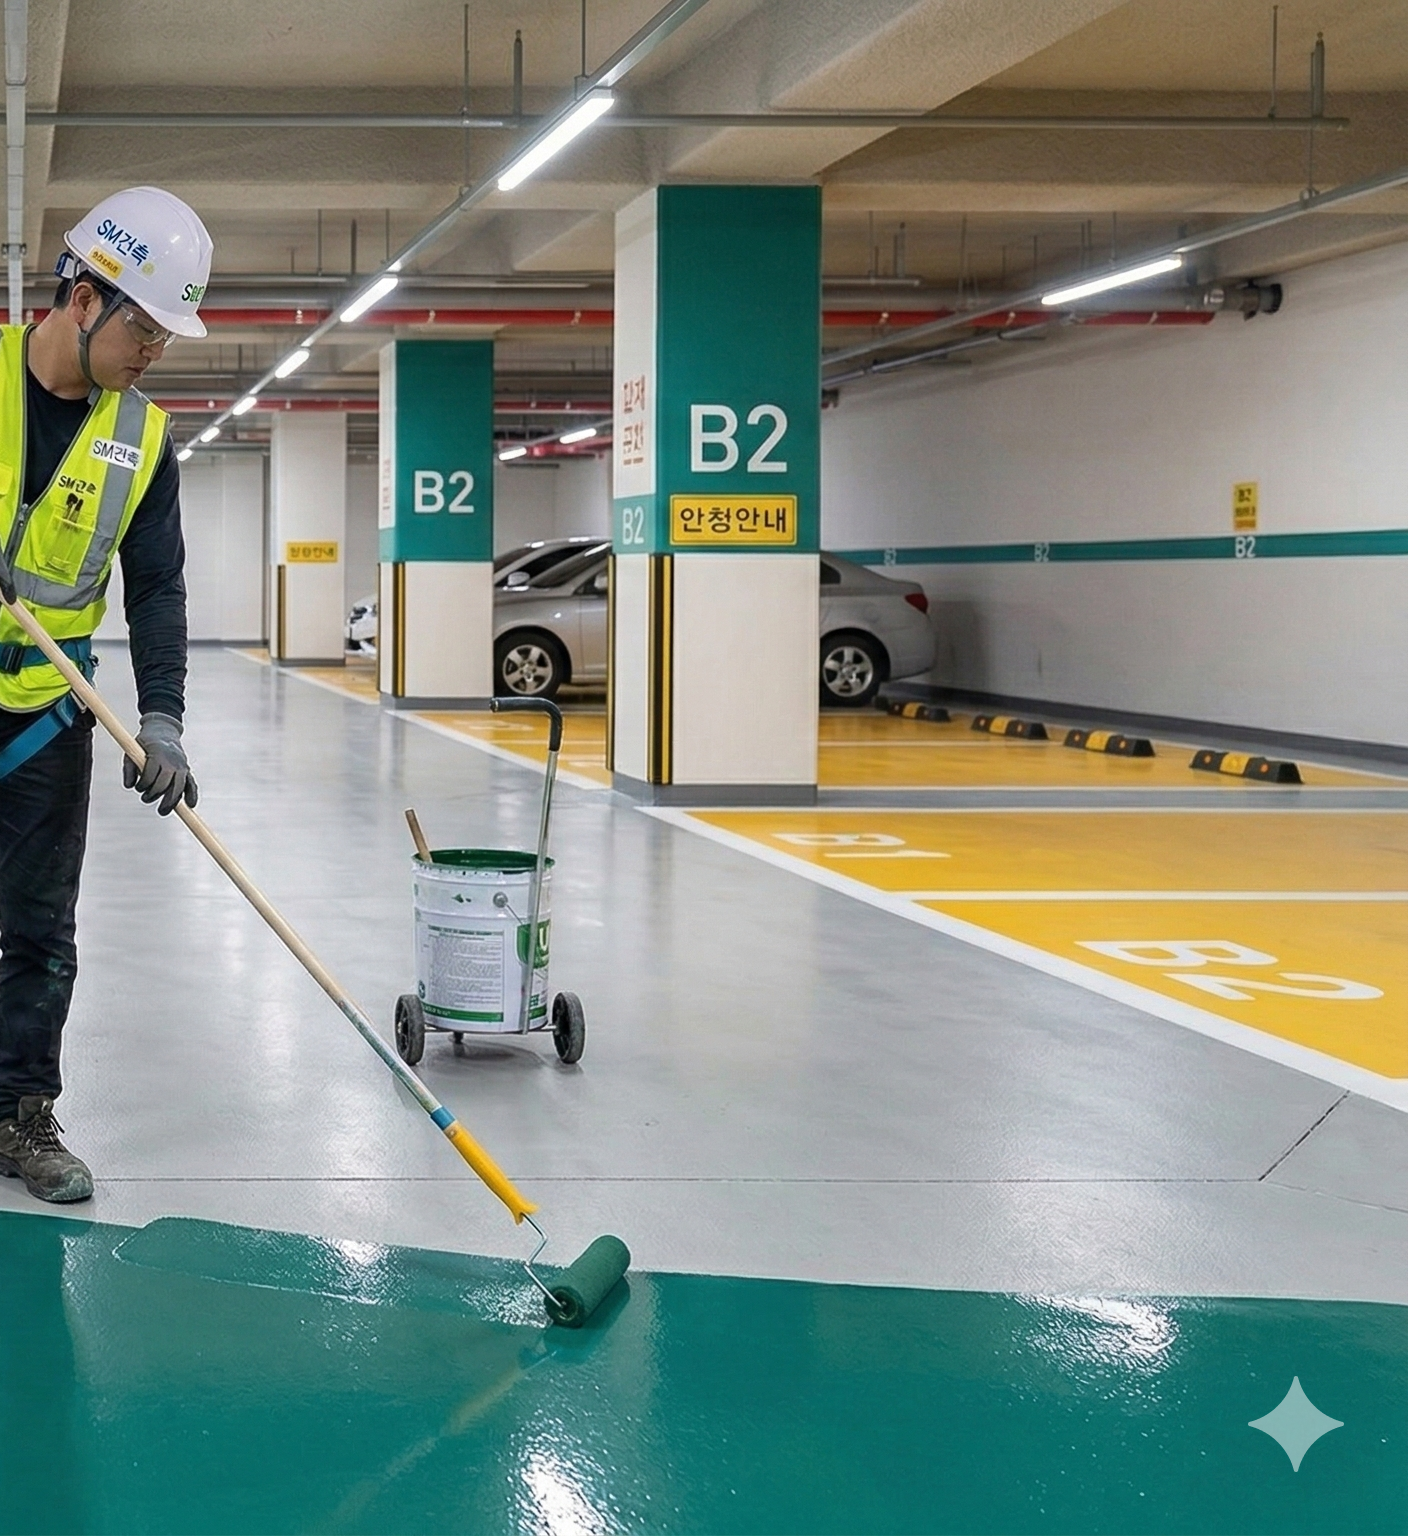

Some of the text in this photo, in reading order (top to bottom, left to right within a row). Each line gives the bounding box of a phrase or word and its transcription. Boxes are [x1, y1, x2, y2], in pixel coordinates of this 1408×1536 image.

[690, 404, 788, 473] B2
[414, 470, 475, 514] B2
[622, 506, 645, 545] B2
[680, 507, 787, 534] 안청안내
[1235, 535, 1257, 559] B2
[1073, 939, 1385, 1001] B2
